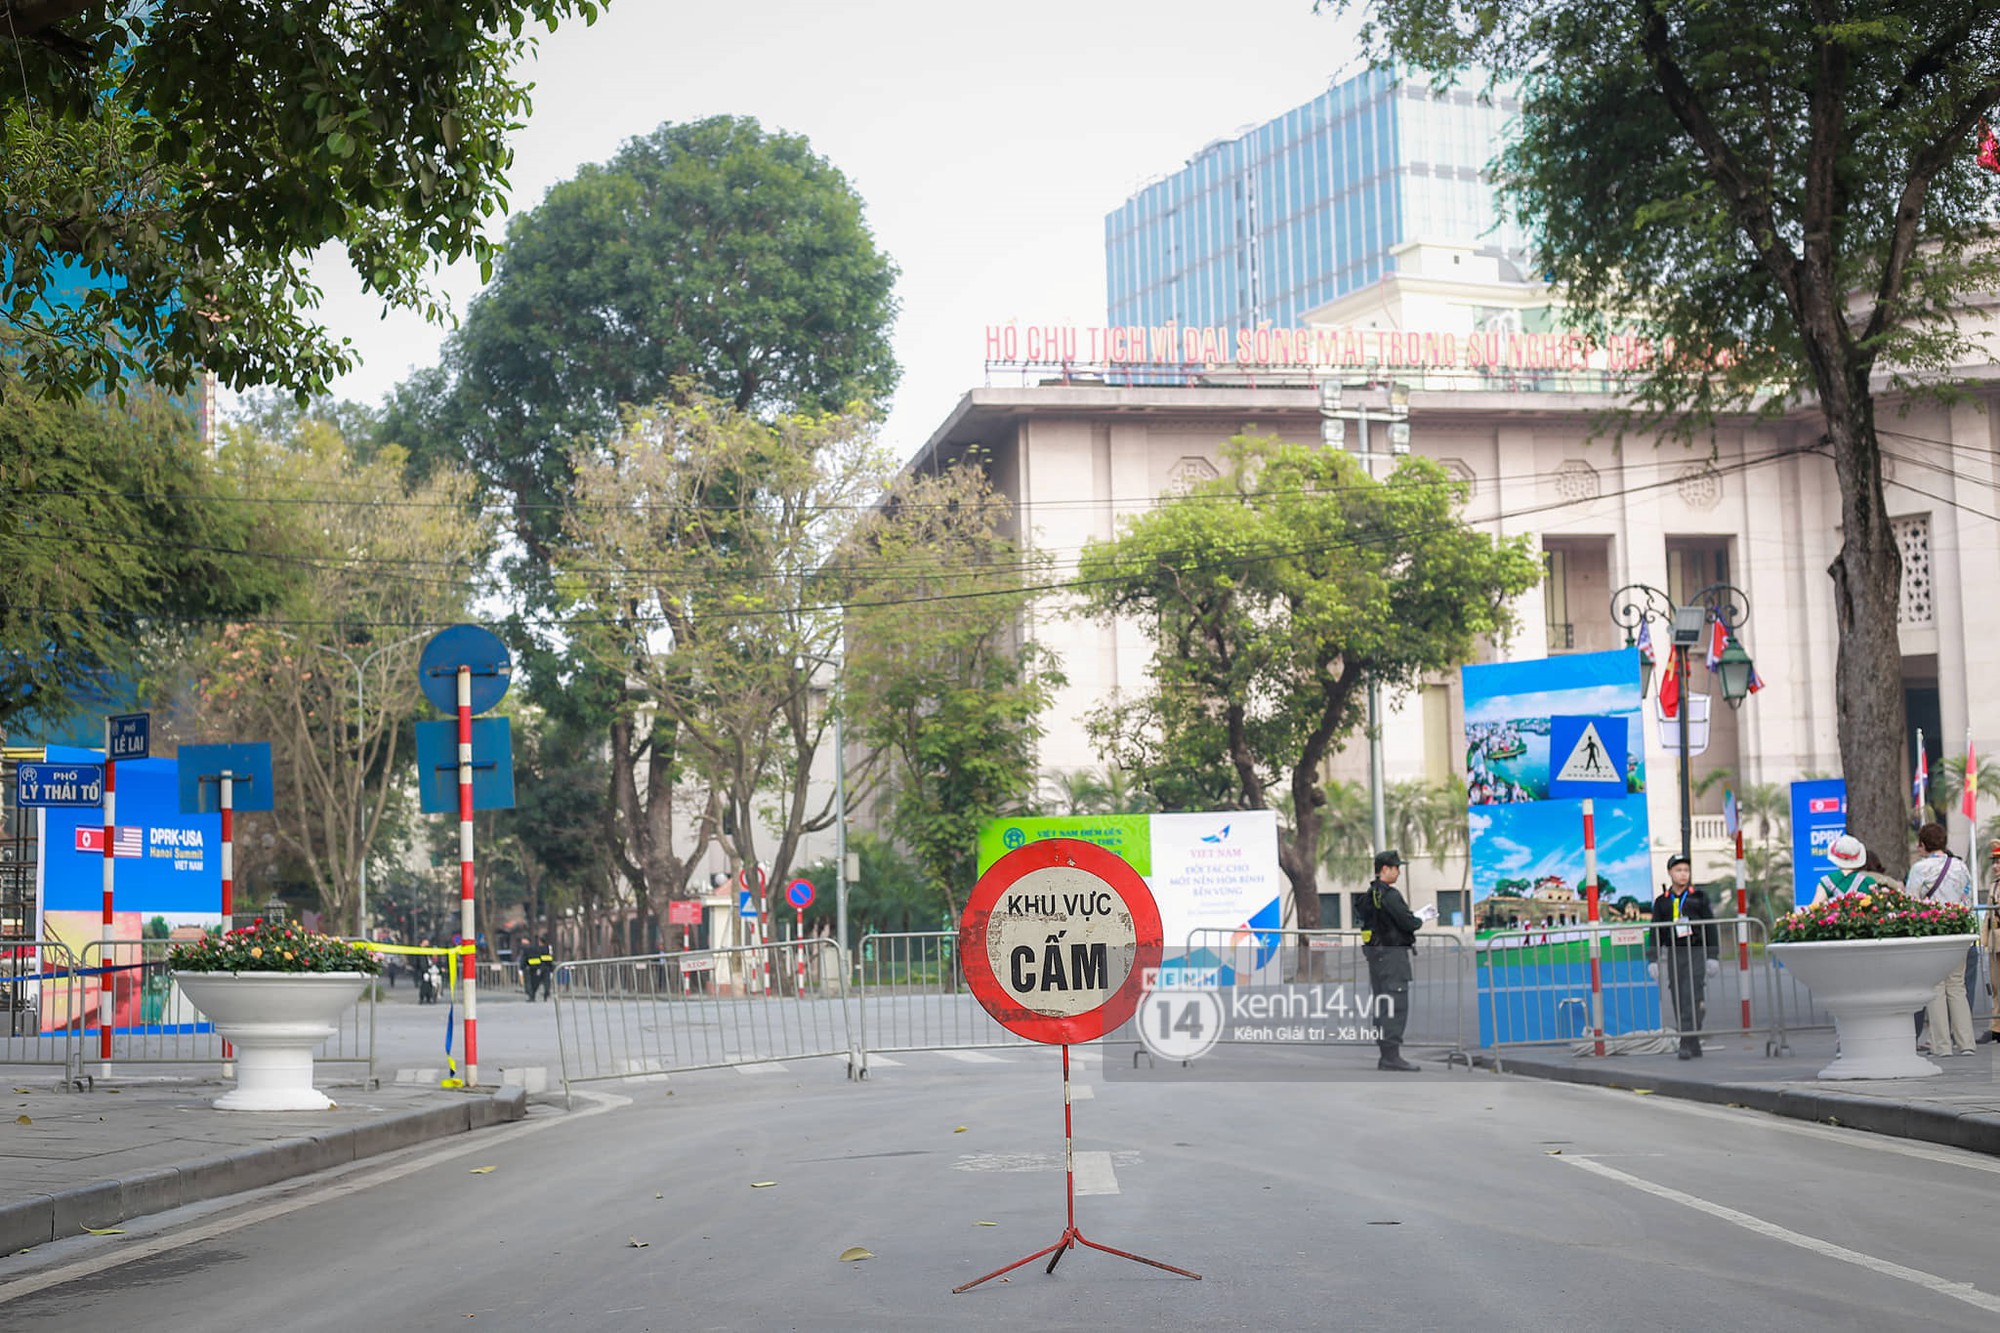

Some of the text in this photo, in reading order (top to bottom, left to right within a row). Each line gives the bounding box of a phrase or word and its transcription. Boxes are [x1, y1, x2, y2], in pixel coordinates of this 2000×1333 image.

[1087, 326, 1146, 368] TỊCH
[1184, 326, 1228, 371] ĐẠI
[1237, 320, 1309, 364] SỐNG
[1376, 331, 1457, 366] TRONG
[114, 734, 144, 754] LÊ LAI
[53, 769, 78, 781] PHỐ
[21, 781, 39, 801] LÝ
[43, 782, 77, 801] THÁI
[150, 827, 204, 847] DPRK-USA
[1217, 847, 1242, 858] NAM
[1007, 891, 1111, 922] KHU VỰC
[1010, 930, 1109, 993] CẤM
